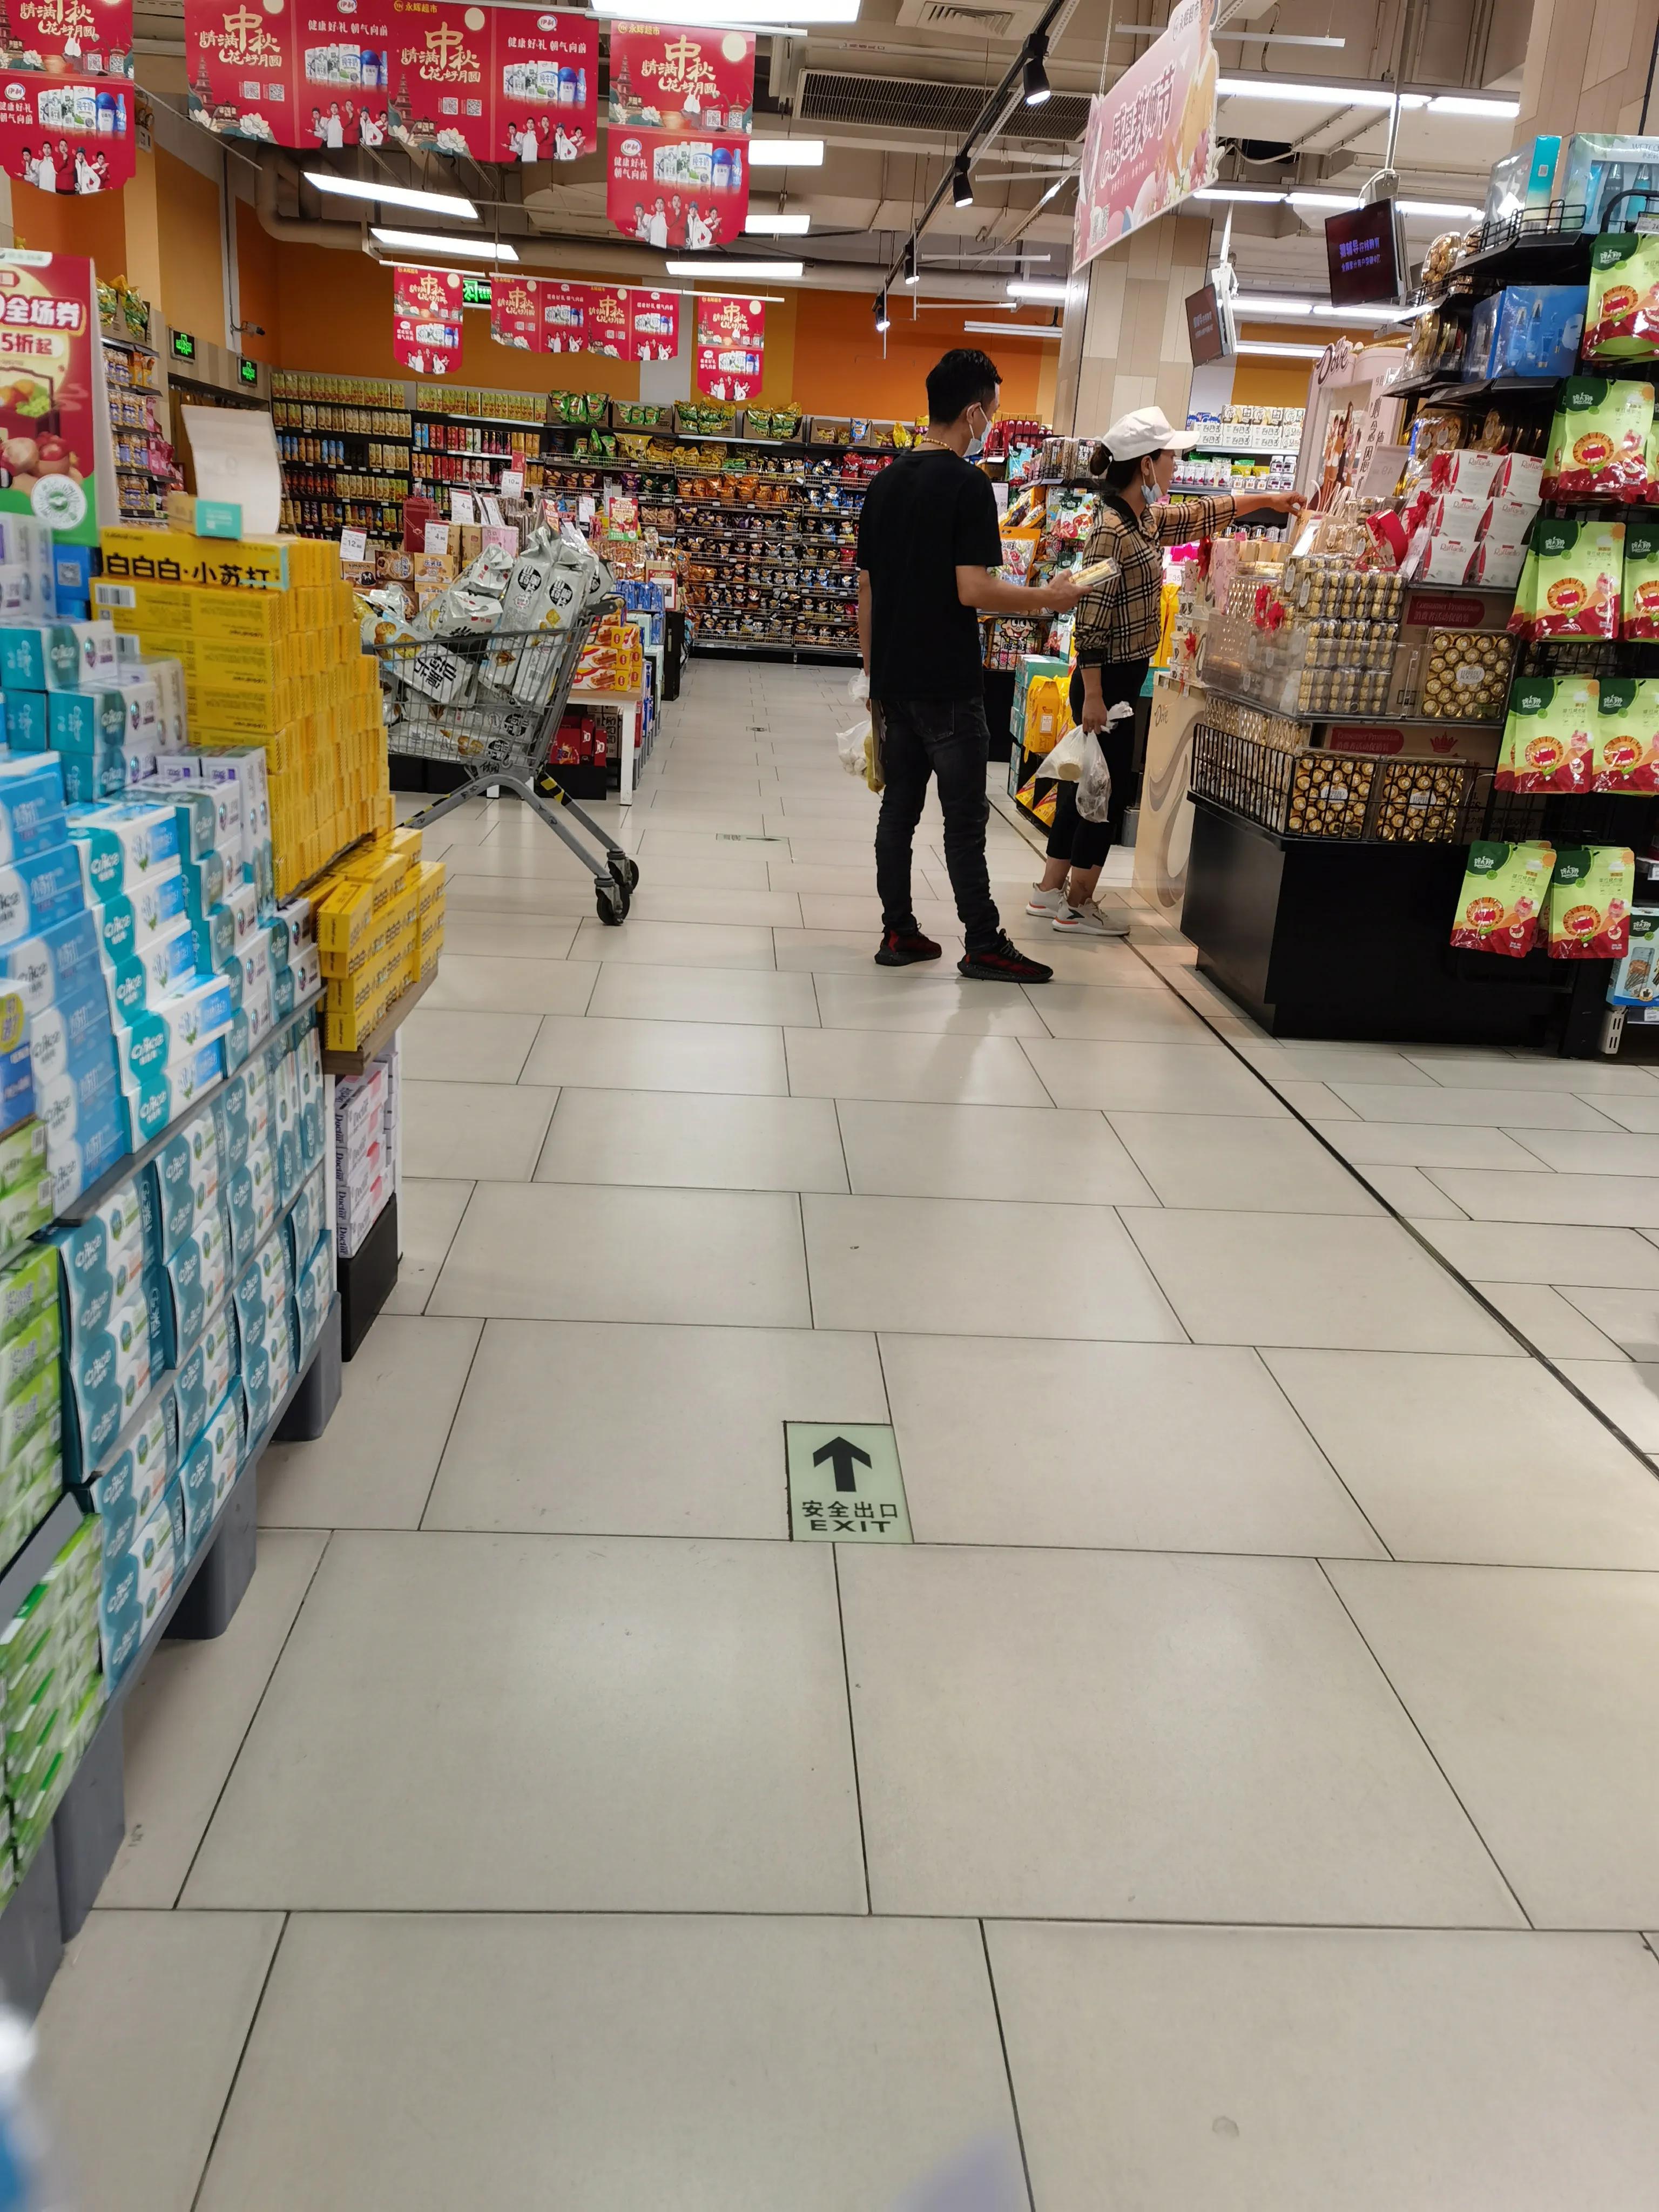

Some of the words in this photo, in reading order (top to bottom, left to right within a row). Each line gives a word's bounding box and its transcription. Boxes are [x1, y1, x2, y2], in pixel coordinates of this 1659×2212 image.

[406, 3, 437, 13] 永辉超市
[38, 21, 95, 37] 花好月圆
[308, 20, 348, 32] 健康好礼
[351, 23, 388, 36] 朝气向前
[629, 24, 660, 35] 永辉超市
[508, 37, 547, 50] 健康好礼
[550, 41, 586, 53] 朝气向前
[219, 49, 281, 67] 花好月圆
[420, 66, 481, 83] 花好月圆
[659, 77, 717, 95] 花好月圆
[614, 157, 648, 168] 健康好礼
[614, 168, 648, 180] 朝气向前
[0, 296, 80, 328] 全场券
[1, 332, 53, 355] 5折起
[1316, 342, 1348, 385] Dove
[1417, 601, 1446, 610] Consumer
[802, 1500, 898, 1518] 安全出口
[811, 1520, 891, 1533] EXIT
